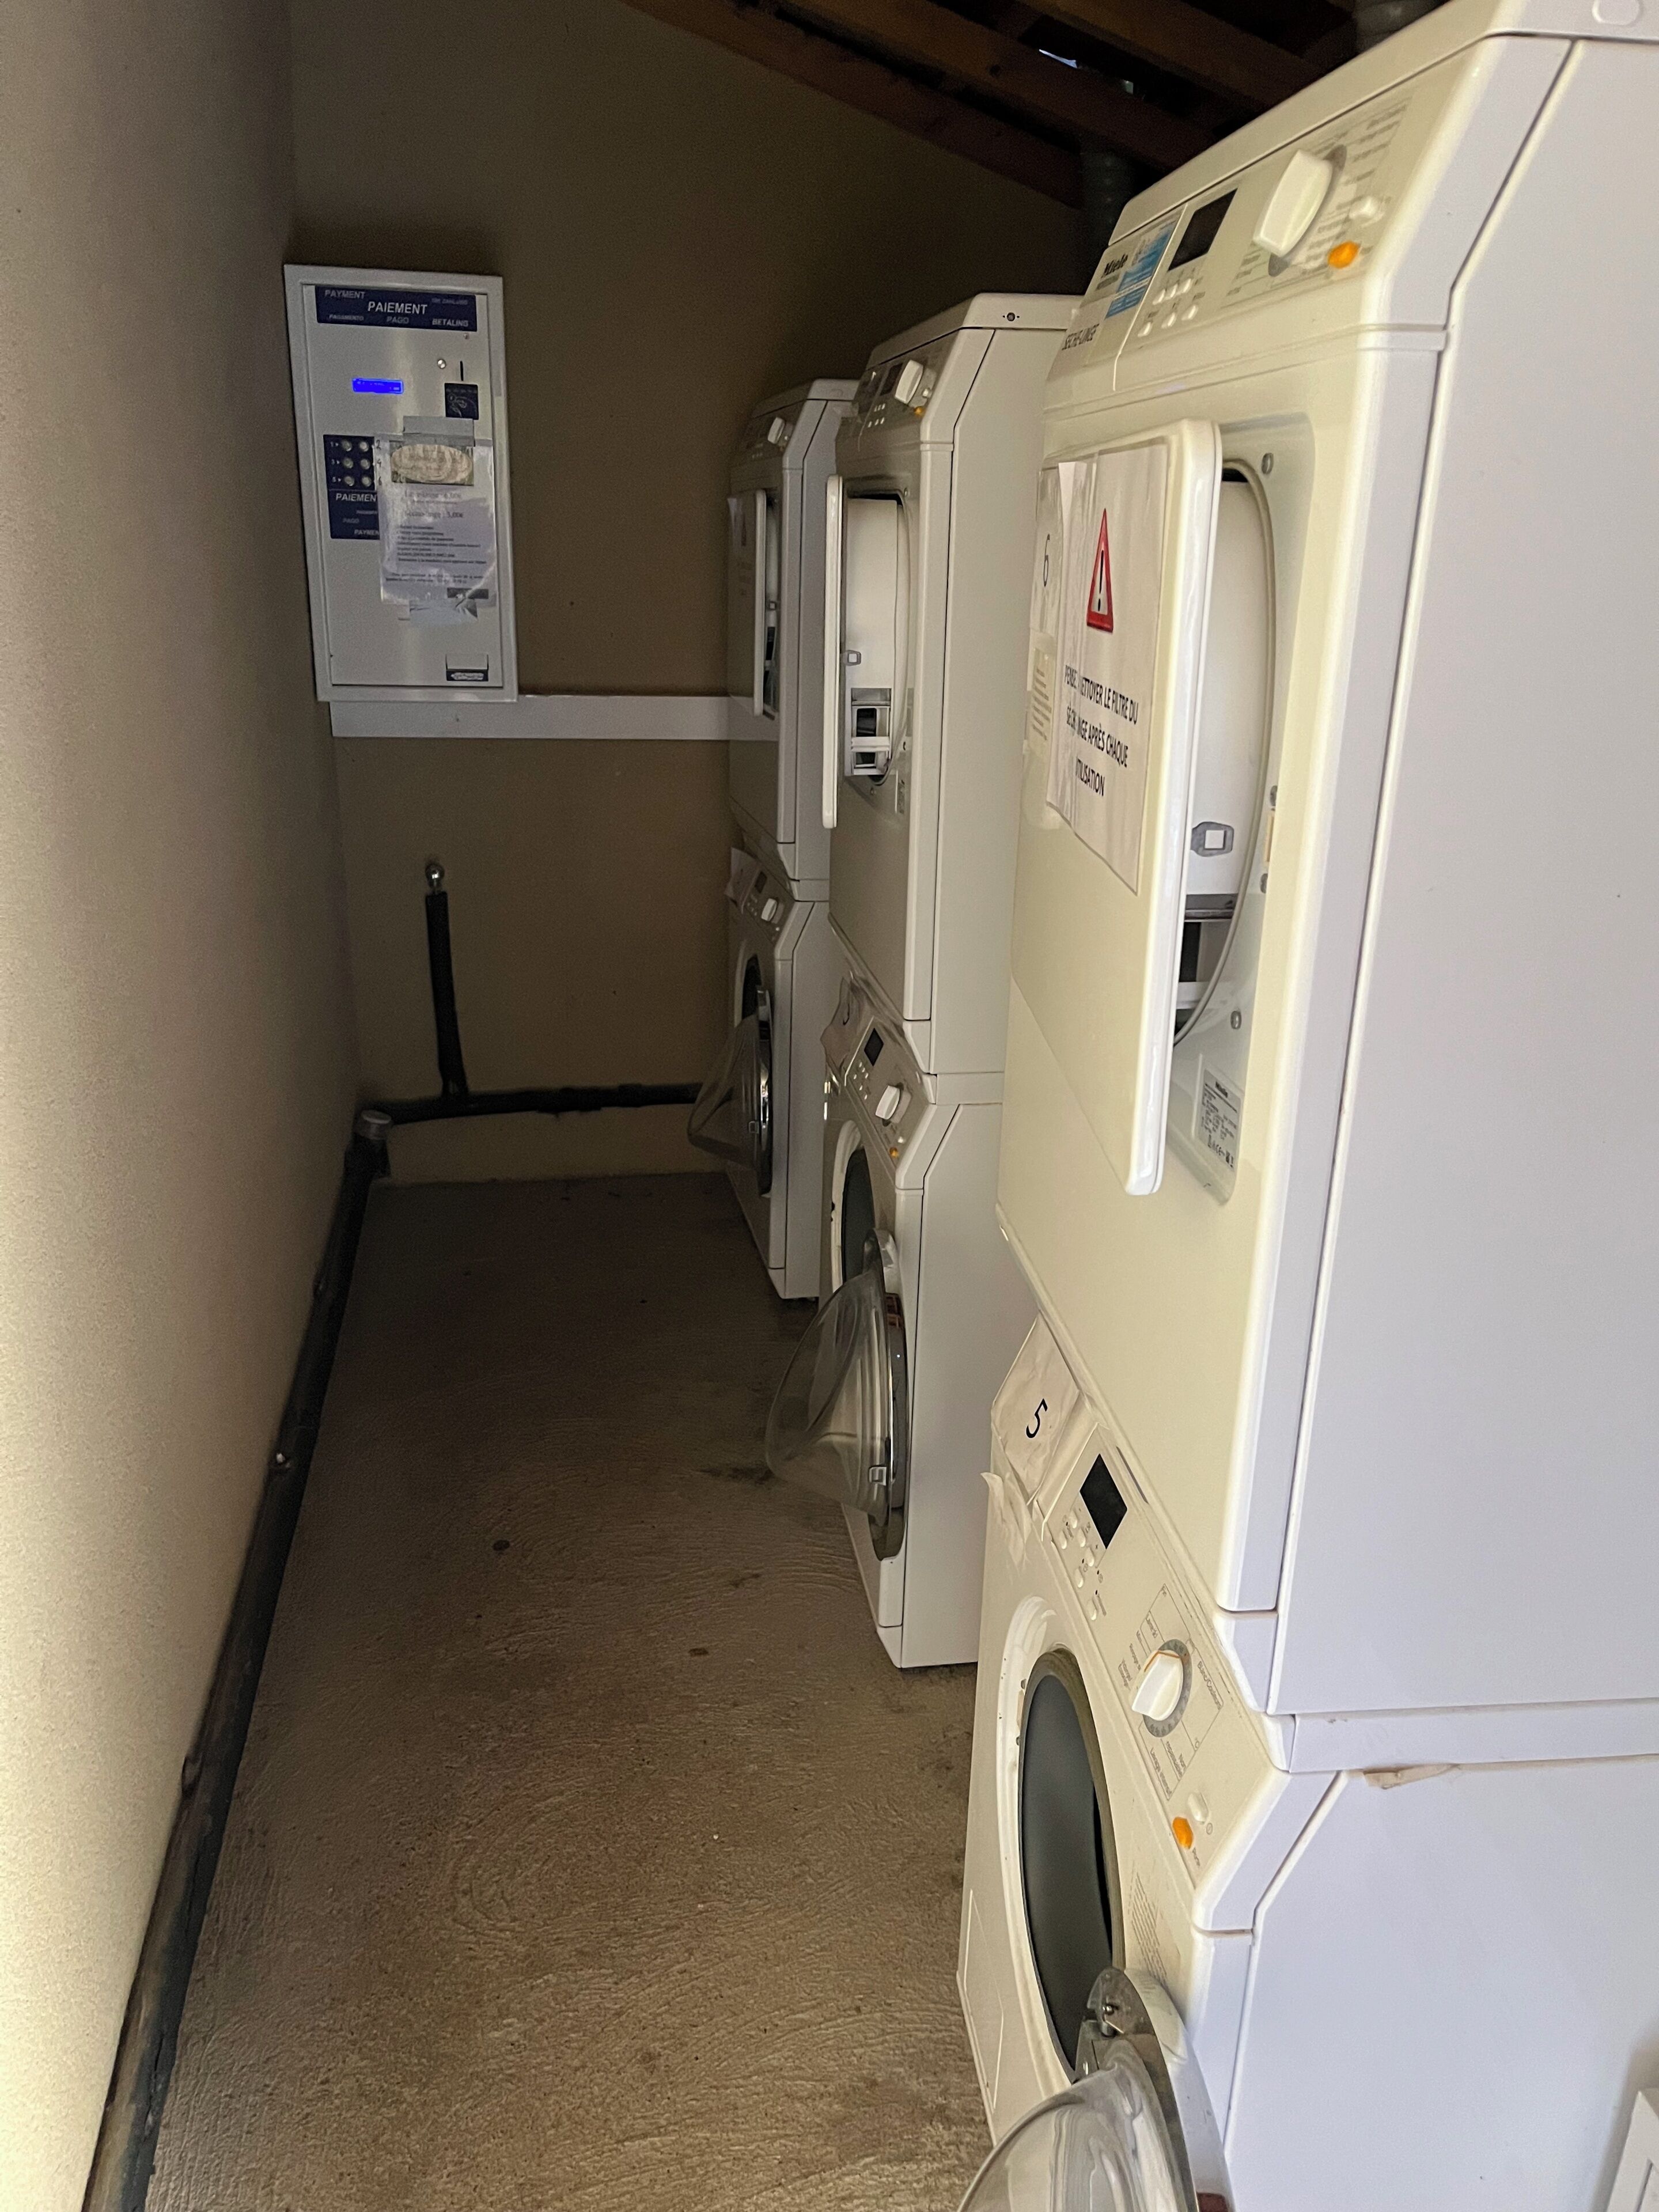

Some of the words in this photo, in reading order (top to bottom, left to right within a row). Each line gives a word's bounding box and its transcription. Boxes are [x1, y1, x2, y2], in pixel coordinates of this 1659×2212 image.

[324, 290, 365, 299] PAYMENT
[368, 301, 427, 315] PAIEMENT
[432, 319, 468, 327] BETALING
[376, 440, 381, 450] 2
[336, 493, 378, 502] PAIEMEN
[1043, 533, 1050, 587] 6
[1104, 687, 1111, 709] LE
[1111, 690, 1128, 719] FILTRE
[1129, 699, 1138, 725] DU
[1088, 723, 1105, 751] APRÈS
[1106, 734, 1128, 768] CHAQUE
[1026, 1398, 1048, 1438] 5
